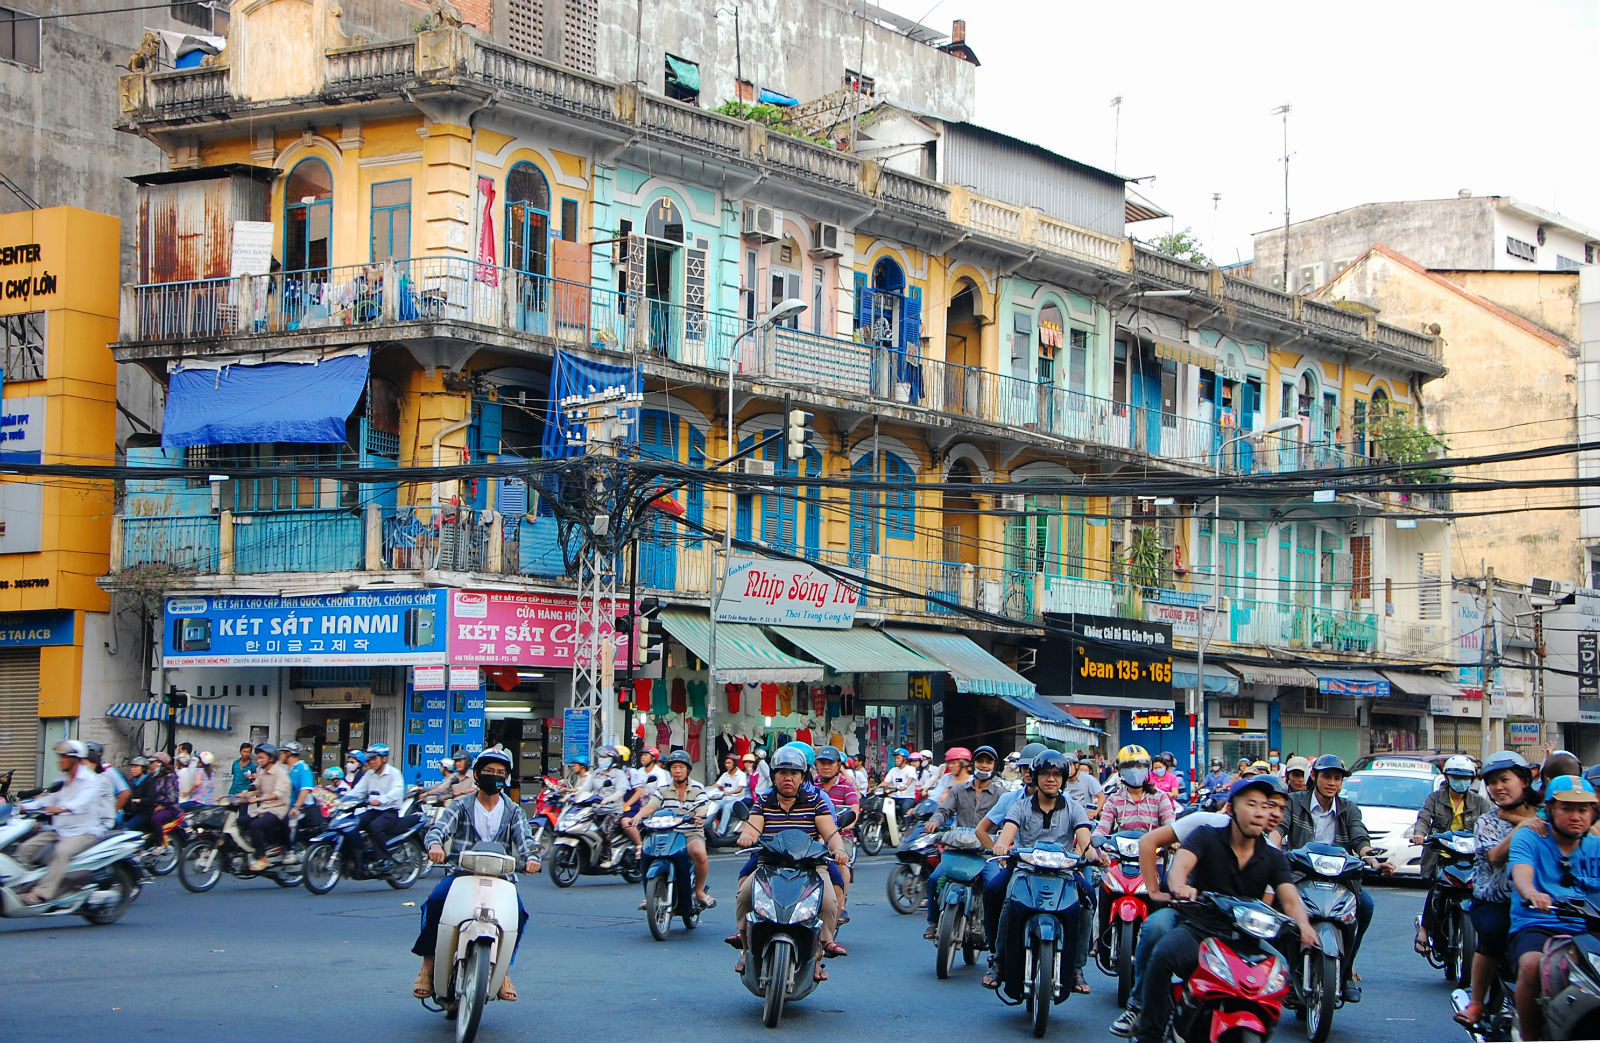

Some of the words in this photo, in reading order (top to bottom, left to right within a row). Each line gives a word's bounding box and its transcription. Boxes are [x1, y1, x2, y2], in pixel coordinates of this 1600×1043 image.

[6, 277, 31, 301] CHỢ
[33, 271, 57, 295] LỚN
[744, 570, 785, 605] Nhịp
[788, 571, 829, 608] Sống
[246, 599, 262, 608] CAO
[516, 605, 535, 619] CỬA
[538, 607, 563, 621] HÀNG
[219, 614, 264, 636] KÉT
[270, 611, 313, 637] SẮT
[321, 614, 399, 634] HANMI
[458, 620, 500, 640] KÉT
[504, 620, 544, 642] SẮT
[28, 629, 50, 640] ACB
[1080, 656, 1114, 679] Jean
[1116, 660, 1139, 681] 135
[1149, 662, 1172, 683] 165
[1511, 724, 1522, 733] NHA
[1524, 724, 1538, 733] KHOA
[1416, 762, 1430, 770] TAXI
